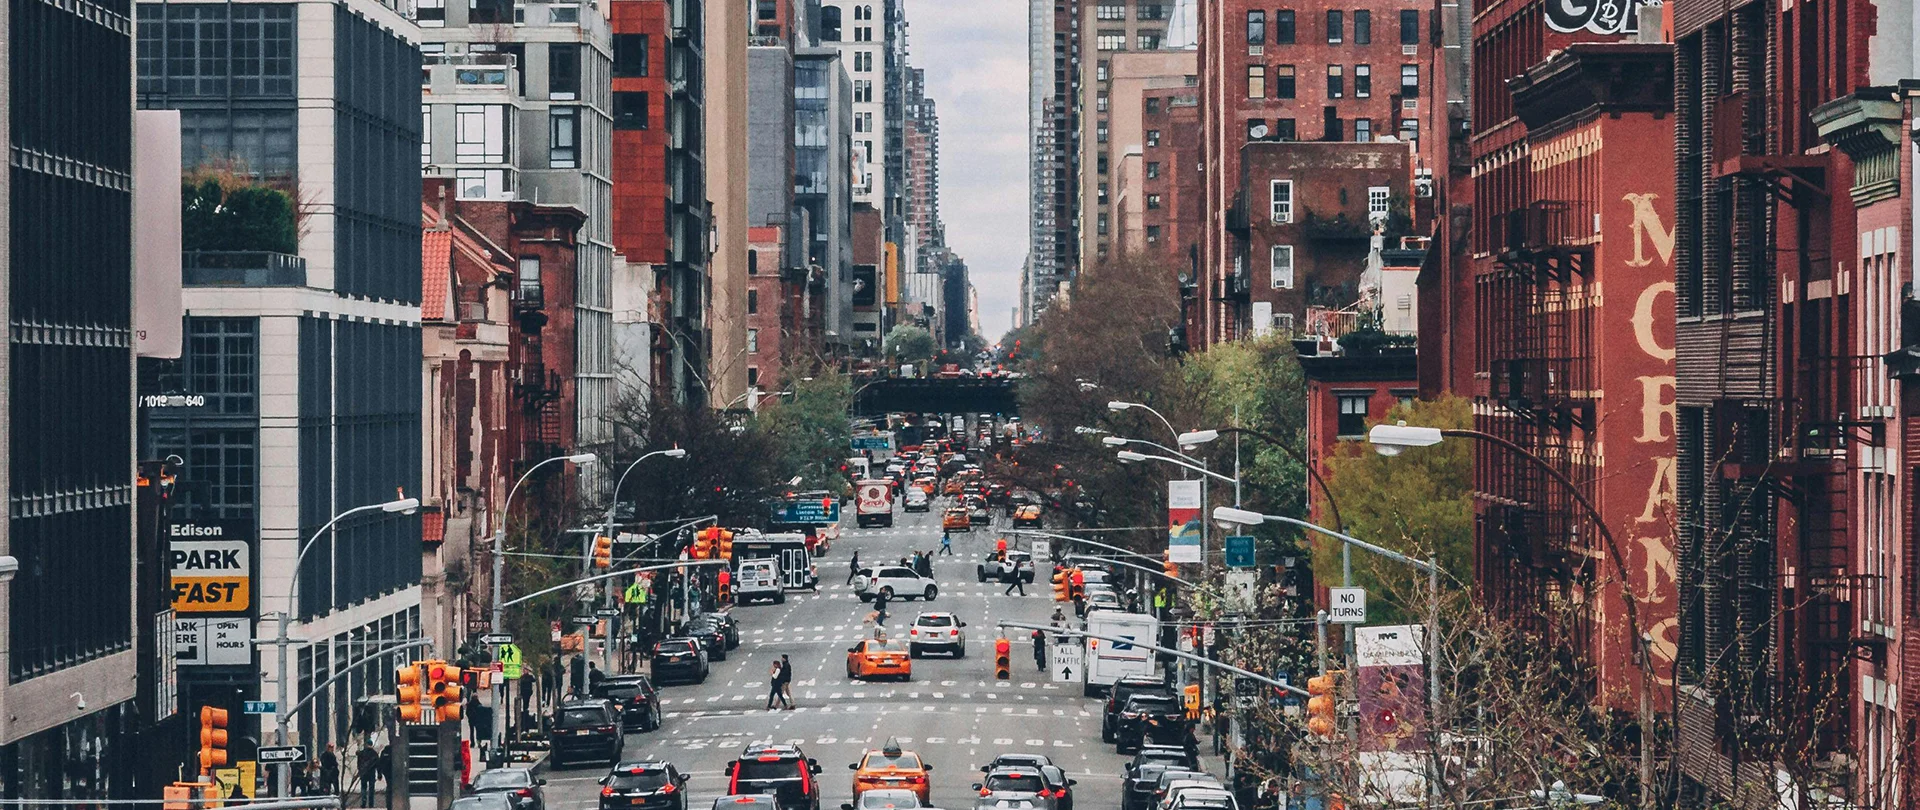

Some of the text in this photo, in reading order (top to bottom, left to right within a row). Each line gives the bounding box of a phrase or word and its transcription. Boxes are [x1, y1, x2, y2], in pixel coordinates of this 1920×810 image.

[135, 329, 147, 341] rg
[170, 523, 223, 537] Edison
[171, 549, 241, 570] PARK
[171, 582, 240, 604] FAST
[1340, 593, 1356, 604] NO
[1332, 607, 1364, 617] TURNS
[175, 621, 198, 632] ARK
[216, 622, 239, 630] OPEN
[175, 633, 198, 644] ERE
[1378, 632, 1398, 640] NYC
[216, 641, 245, 649] HOURS
[1060, 647, 1074, 655] ALL
[1054, 656, 1081, 665] TRAFFIC
[246, 703, 255, 711] W
[257, 703, 266, 711] 19
